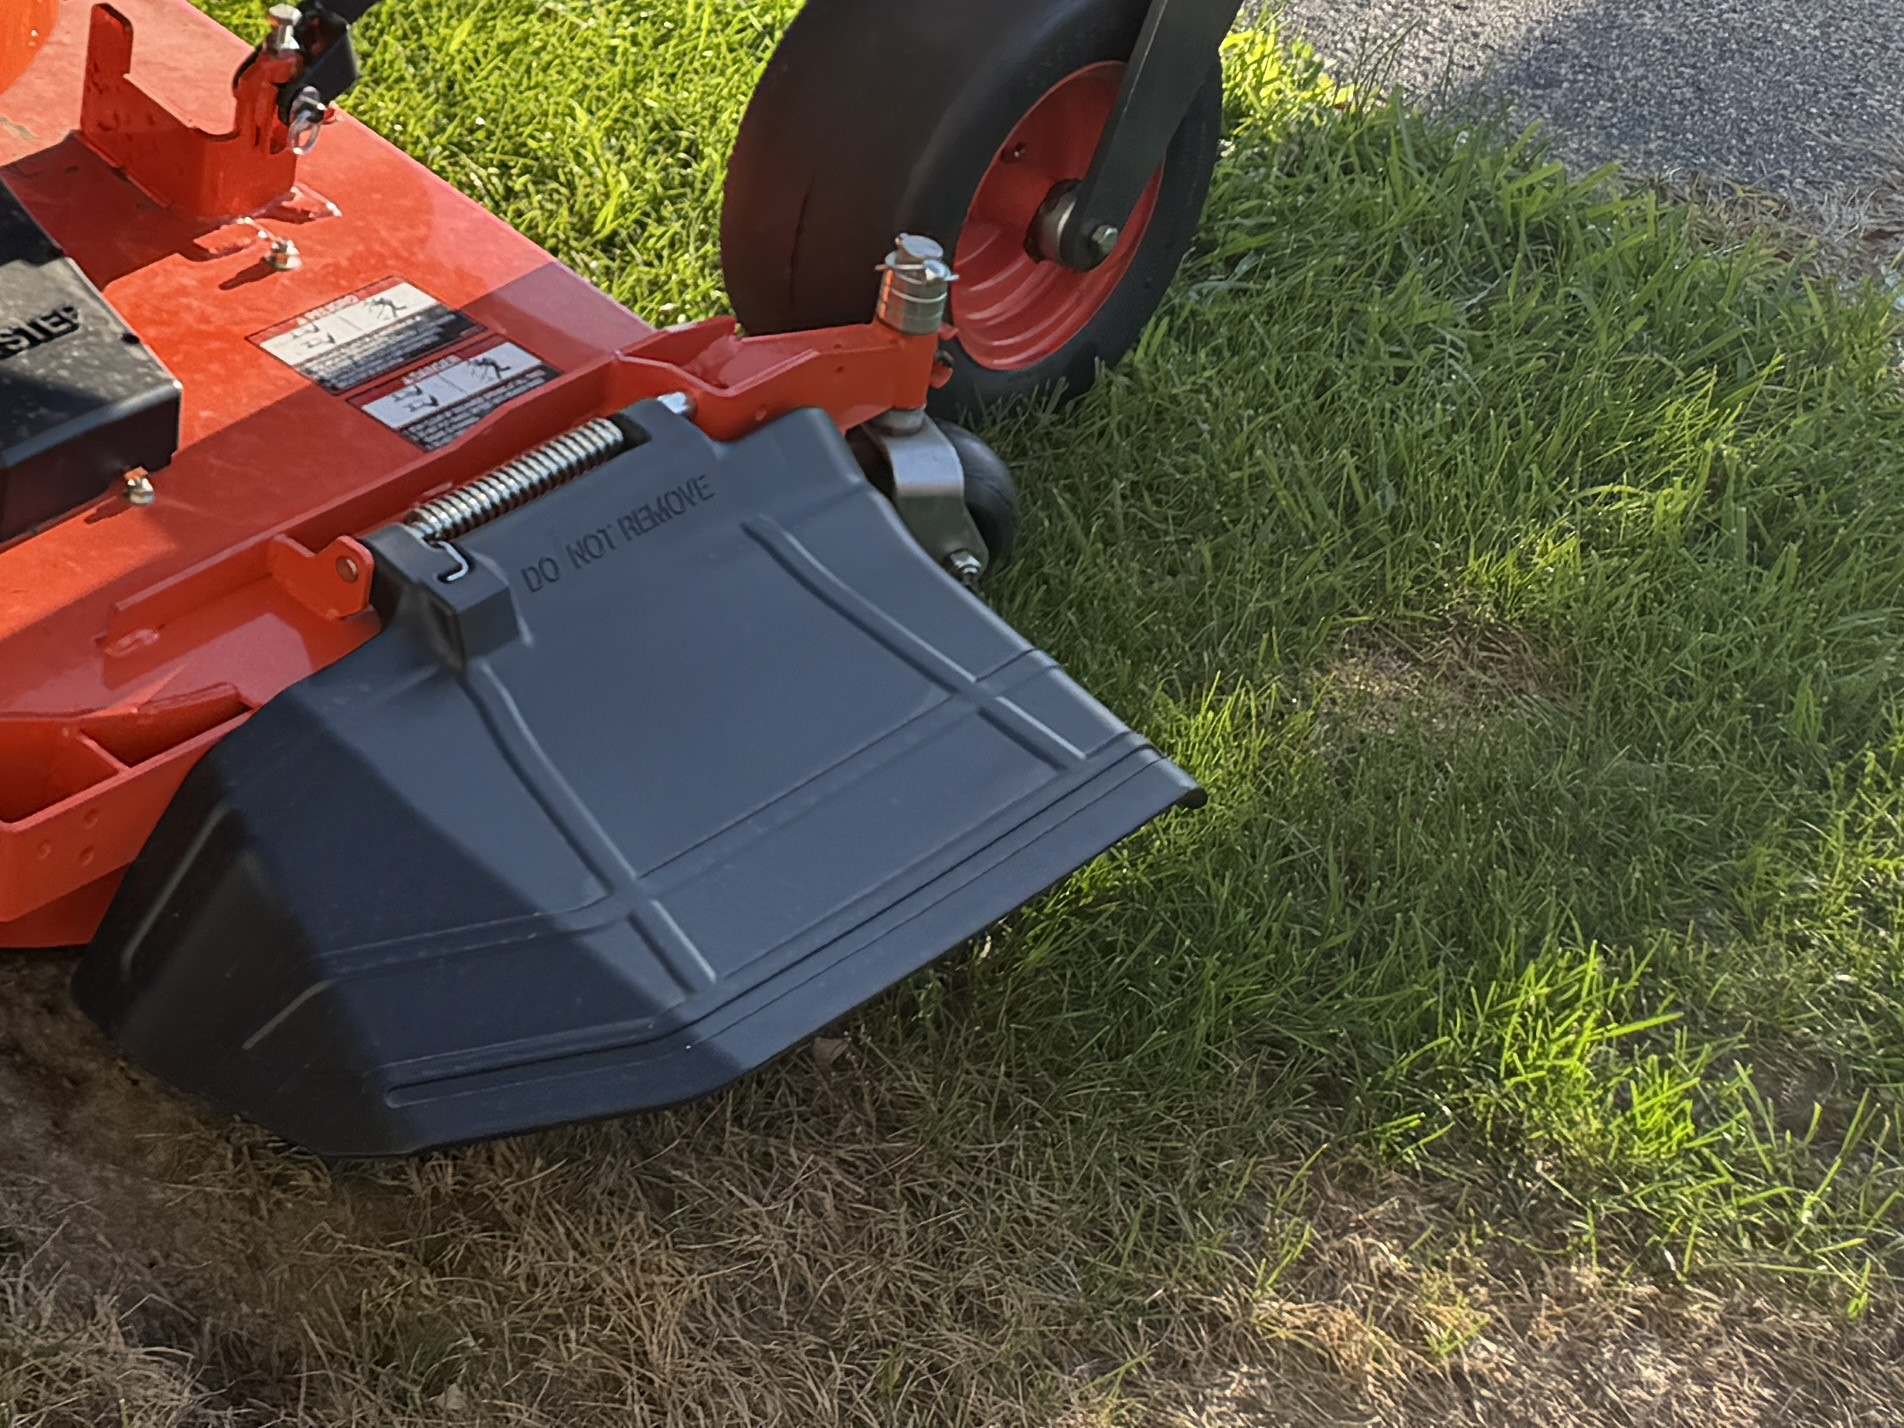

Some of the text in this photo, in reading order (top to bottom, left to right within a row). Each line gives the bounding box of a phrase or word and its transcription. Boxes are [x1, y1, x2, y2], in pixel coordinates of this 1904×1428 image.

[520, 474, 716, 593] DO NOT REMOVE
